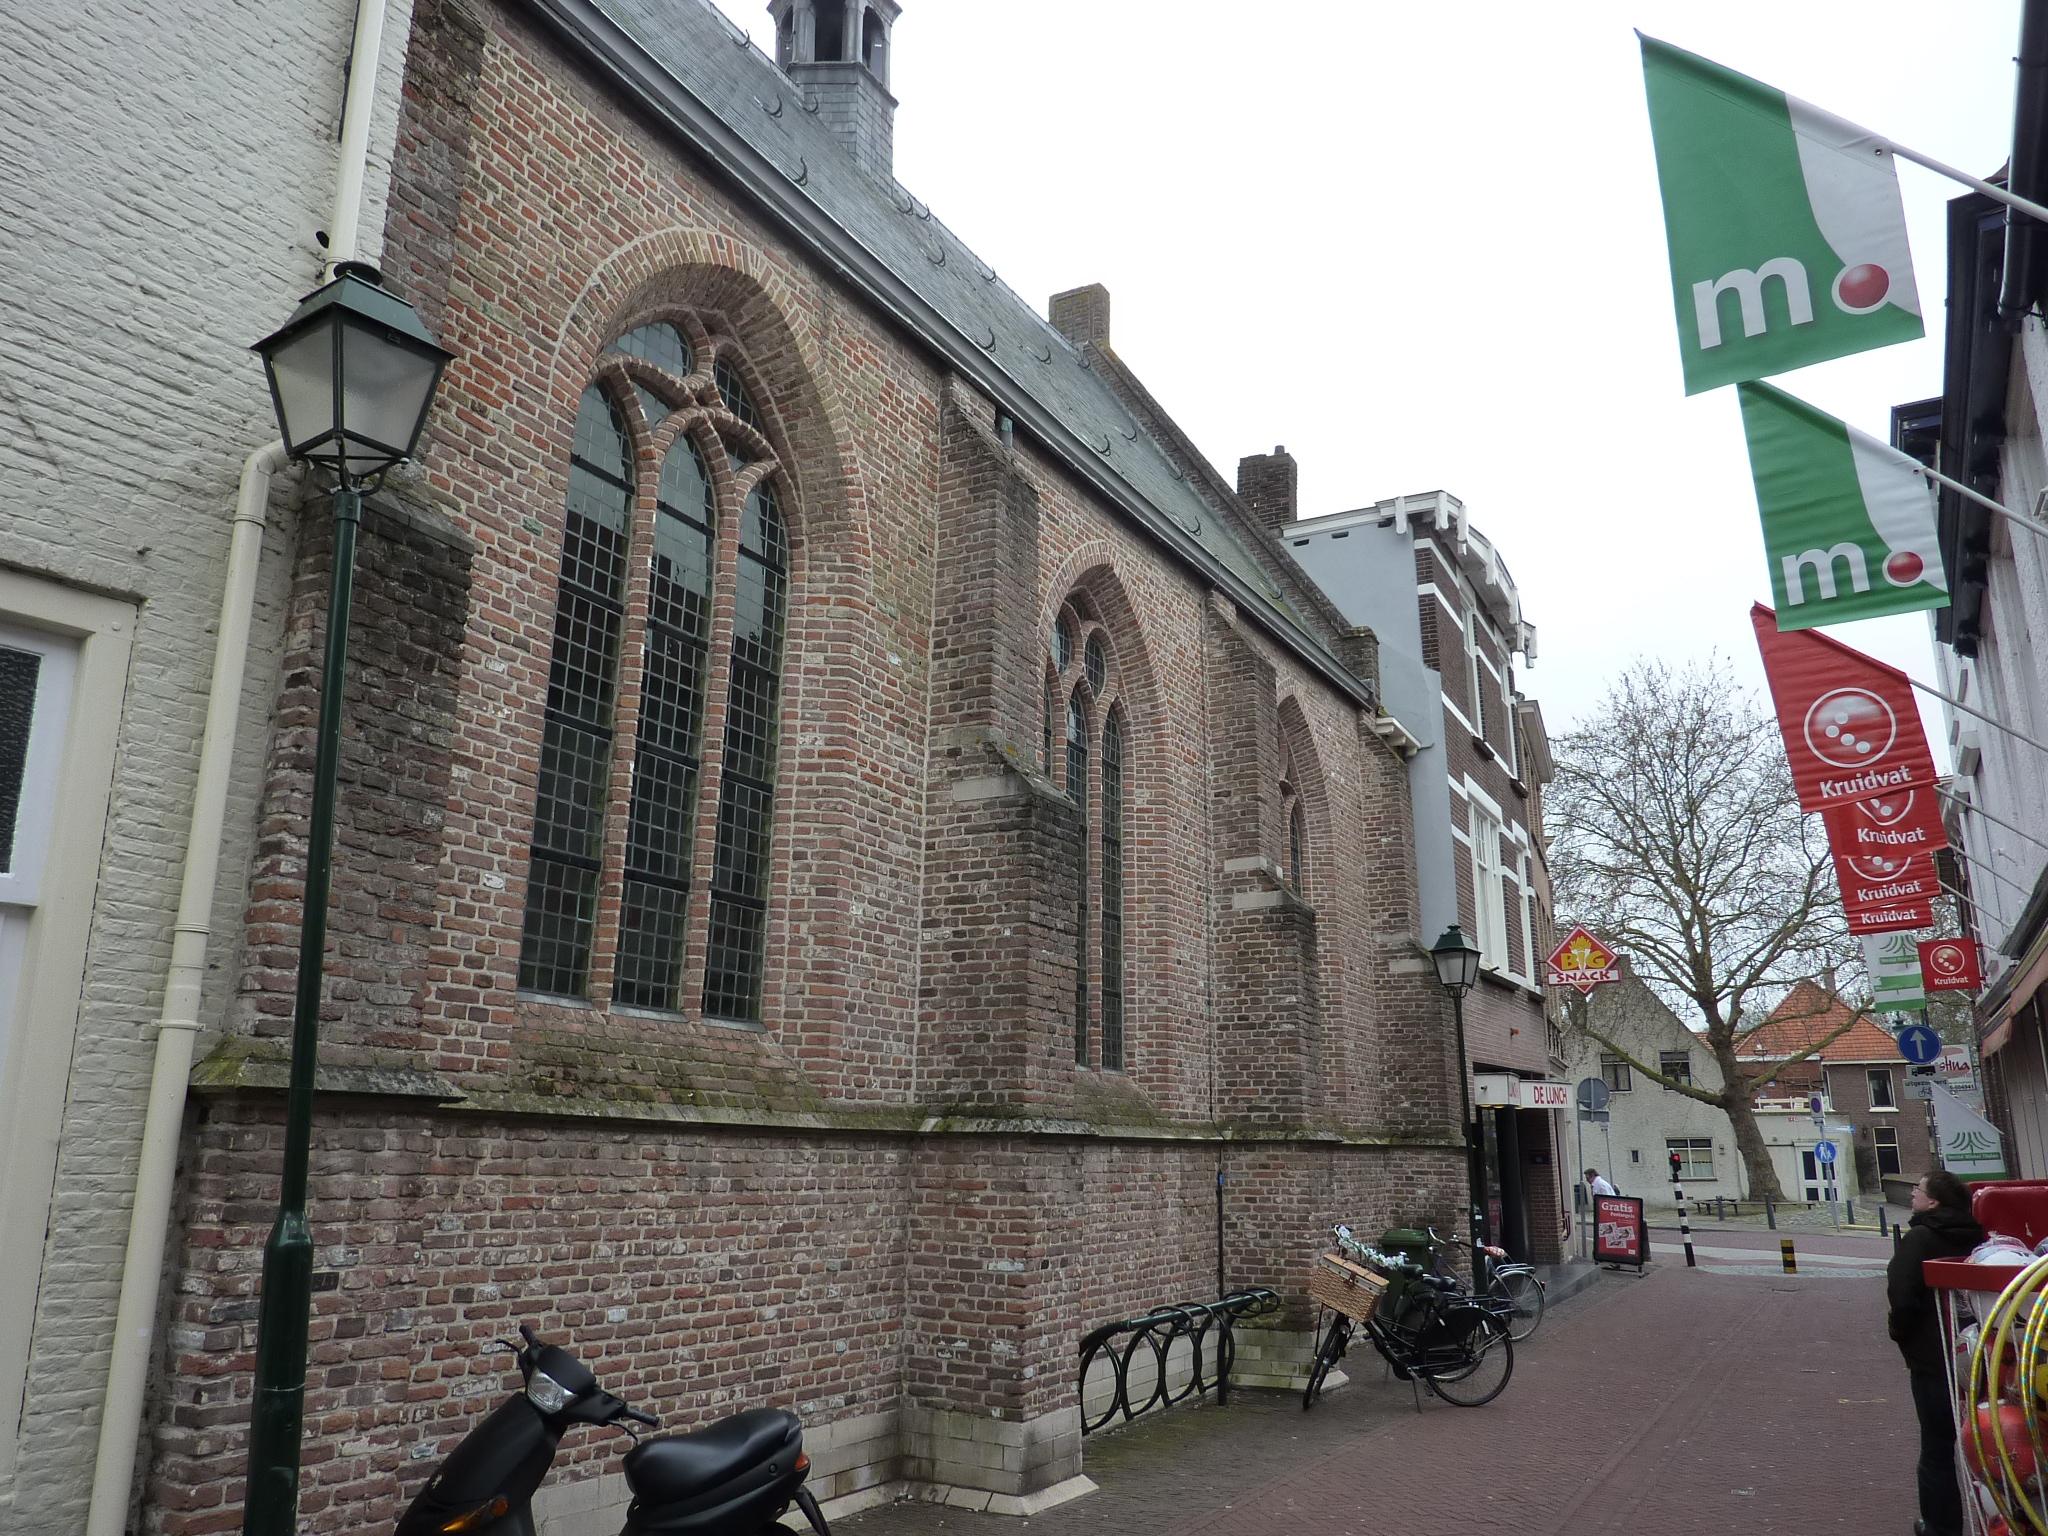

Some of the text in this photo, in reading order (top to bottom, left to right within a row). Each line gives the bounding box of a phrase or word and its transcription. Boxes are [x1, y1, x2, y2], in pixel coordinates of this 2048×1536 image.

[1820, 765, 1913, 799] Kruidvat
[1857, 827, 1926, 845] Kruidvat
[1857, 880, 1922, 902] Kruidvat
[1861, 909, 1918, 924] Kruidvat
[1556, 970, 1610, 982] SNACK
[1934, 976, 1969, 985] Kruidvat
[1534, 1086, 1545, 1104] DE
[1546, 1087, 1568, 1105] LUNCH
[1601, 1201, 1633, 1213] Gratis
